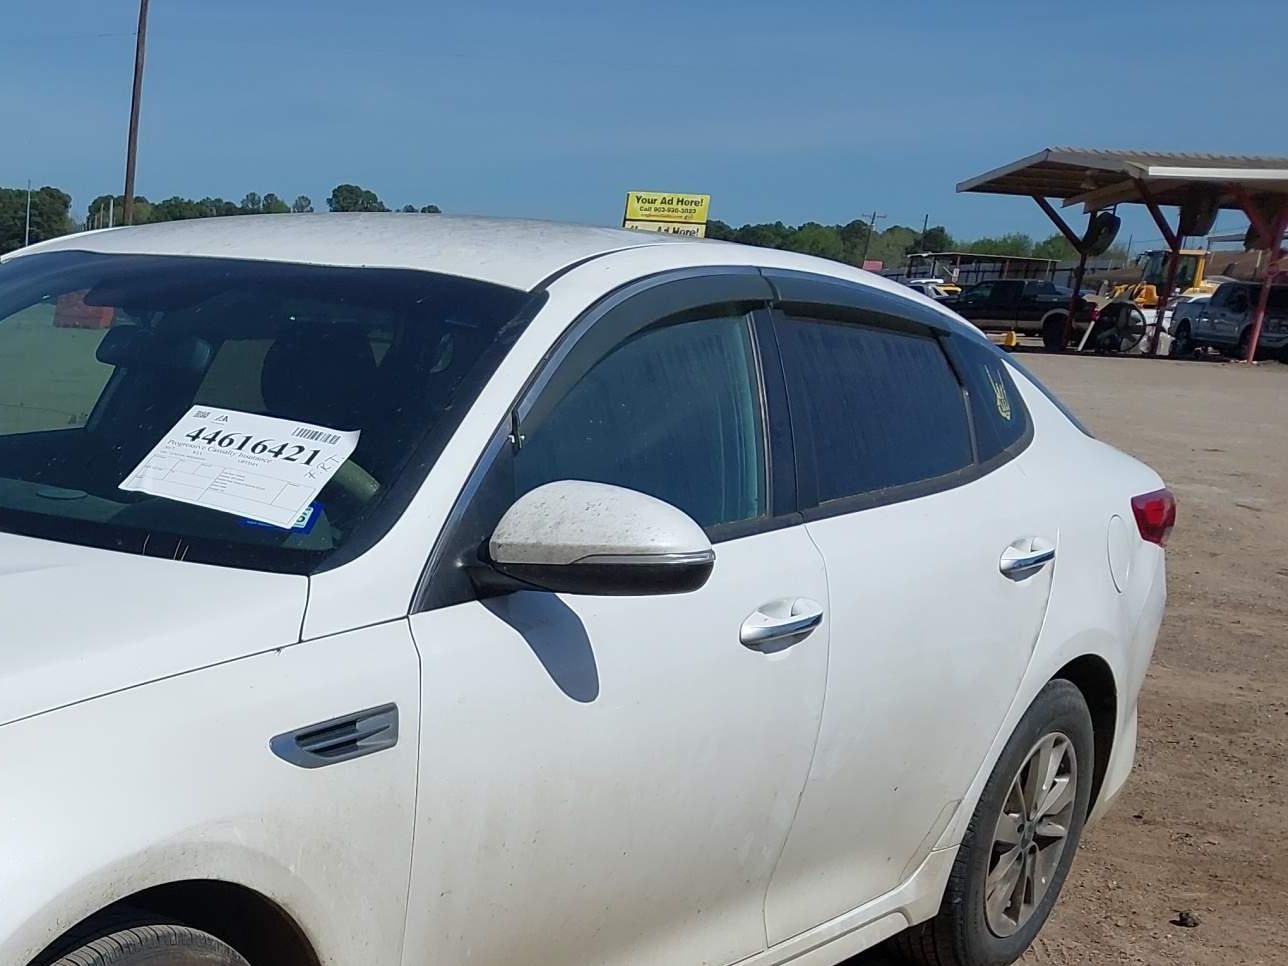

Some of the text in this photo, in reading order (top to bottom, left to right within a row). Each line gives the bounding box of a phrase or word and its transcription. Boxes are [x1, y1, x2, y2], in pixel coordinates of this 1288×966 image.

[635, 195, 703, 207] Your Ad Here!
[184, 426, 321, 466] 44616421
